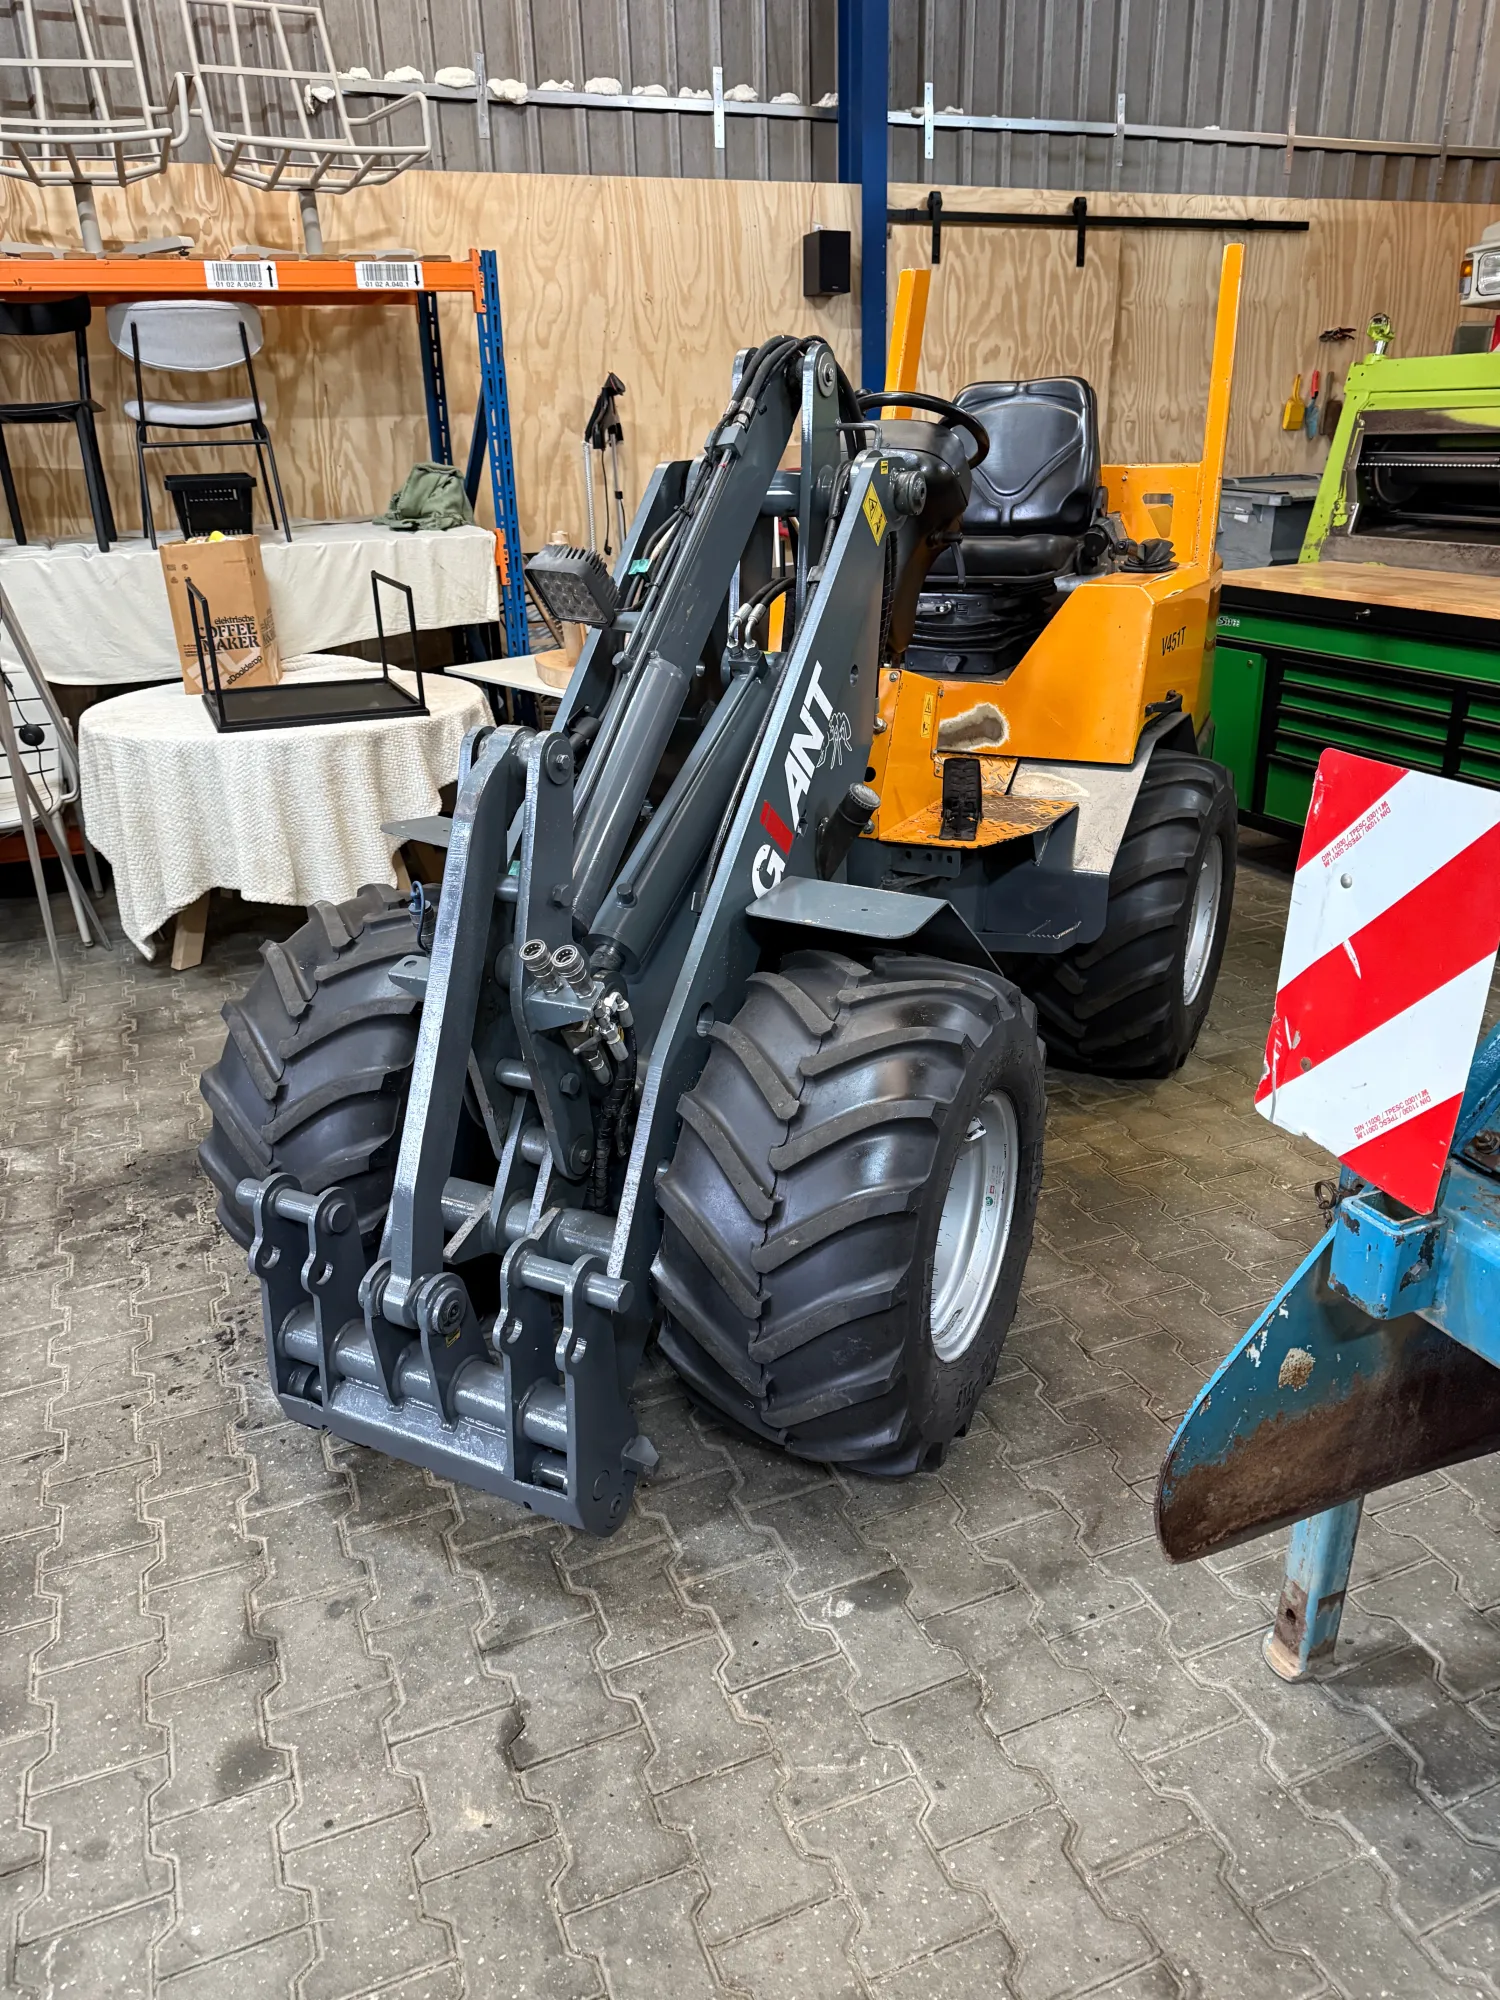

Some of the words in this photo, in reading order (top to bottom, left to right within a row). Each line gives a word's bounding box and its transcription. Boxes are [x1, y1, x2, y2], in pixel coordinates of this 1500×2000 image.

[214, 614, 255, 625] elektrische
[1162, 626, 1187, 656] V451T
[751, 660, 834, 899] GIANT
[1321, 850, 1332, 863] DIN
[1331, 838, 1346, 854] 11030
[1349, 819, 1367, 838] TPESC
[1353, 1124, 1365, 1134] DIN
[1365, 1115, 1381, 1127] 11030
[1384, 1102, 1405, 1117] TPESC
